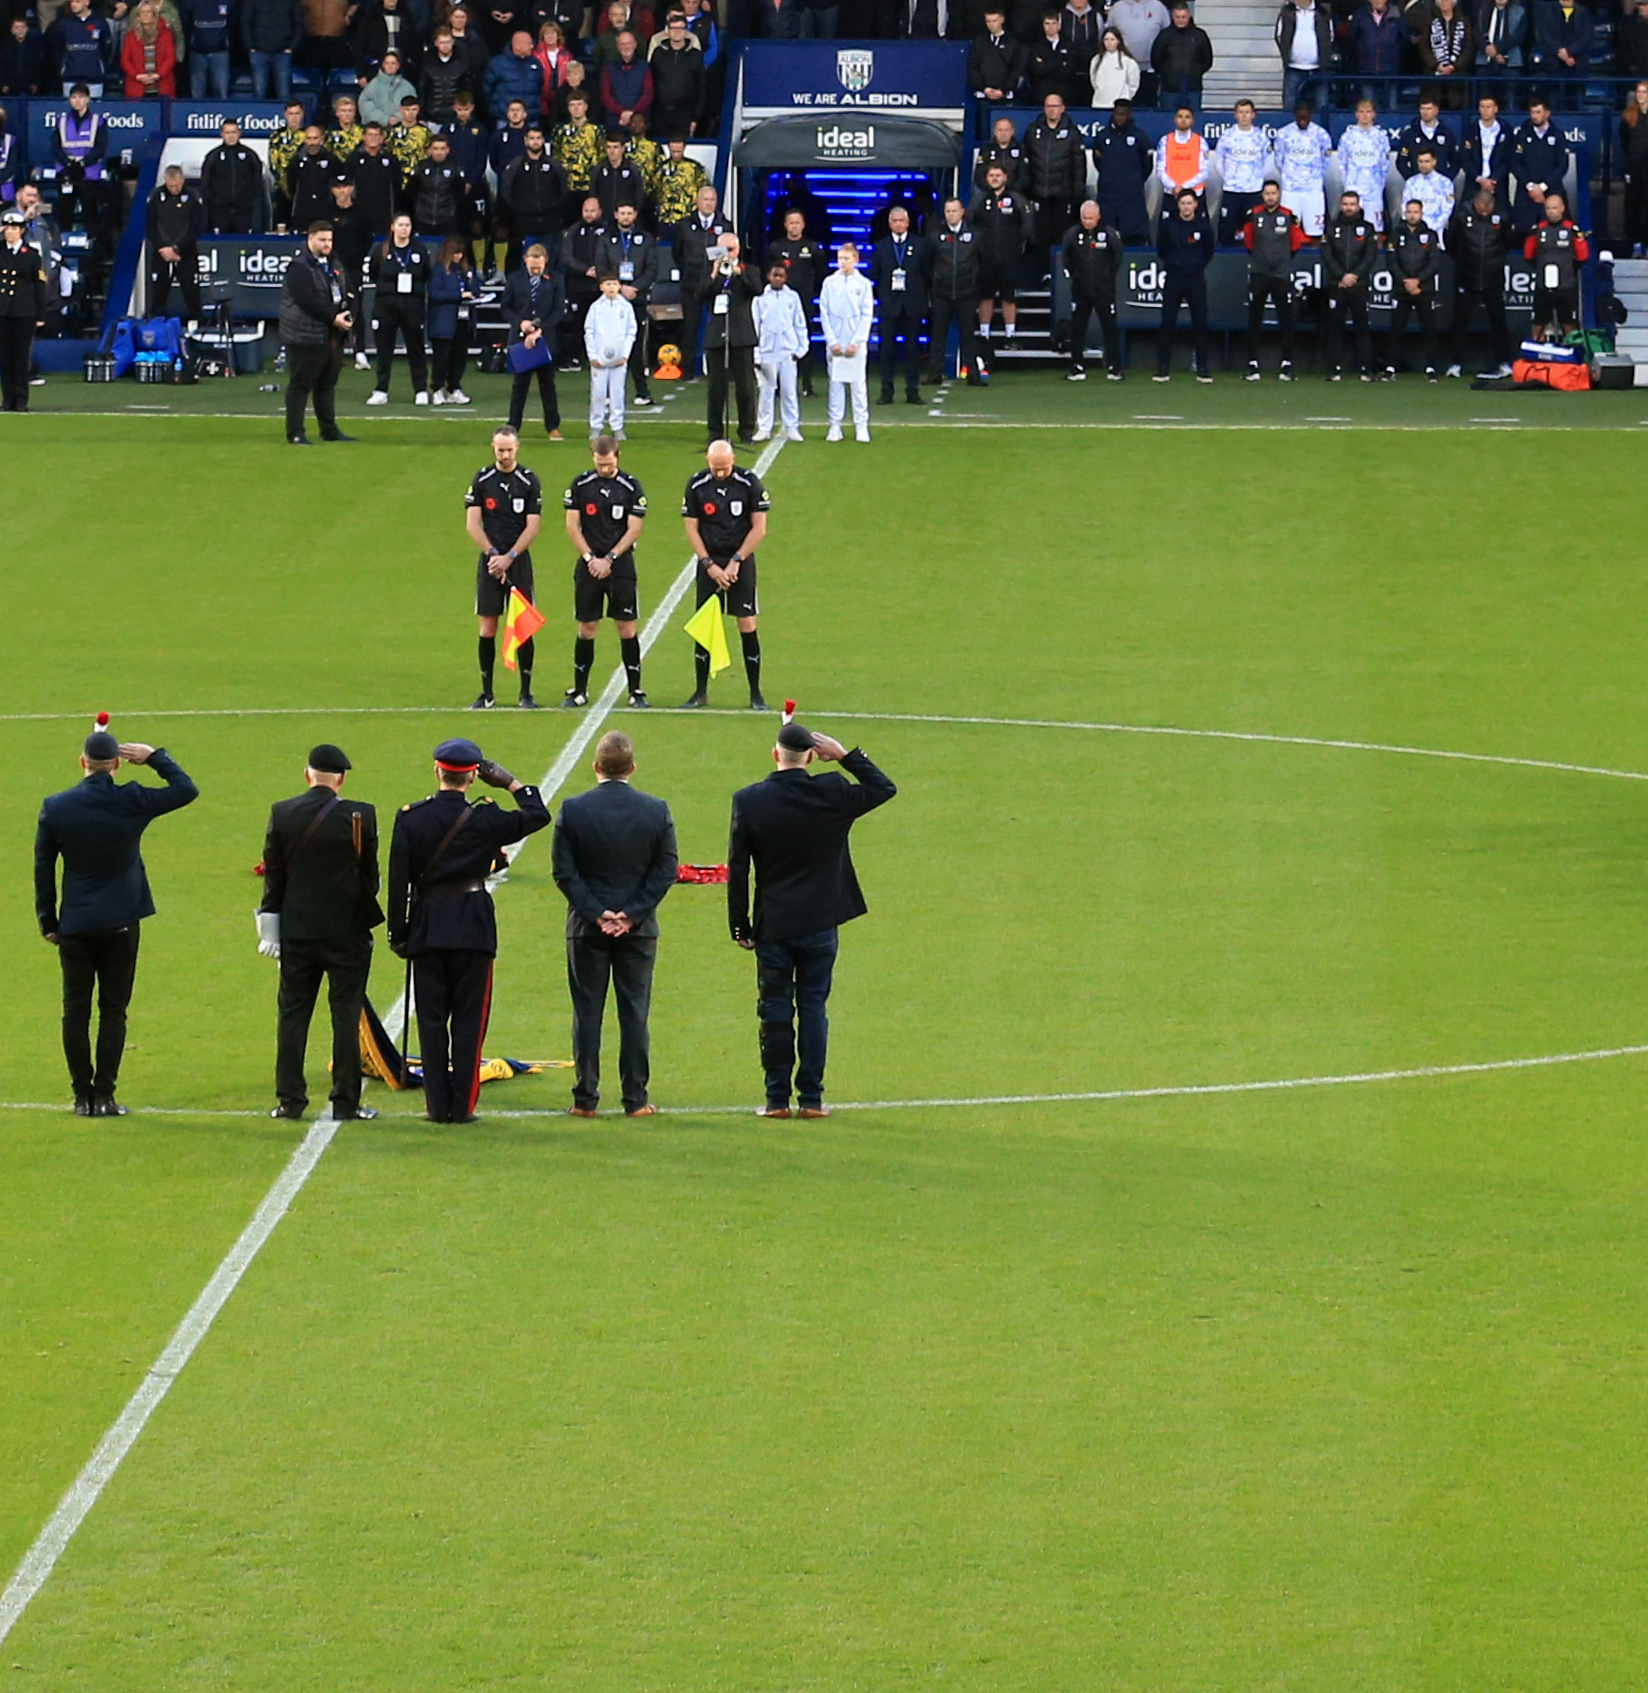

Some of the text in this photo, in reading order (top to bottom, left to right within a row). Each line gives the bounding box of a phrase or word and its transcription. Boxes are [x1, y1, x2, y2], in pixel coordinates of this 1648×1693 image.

[793, 94, 918, 105] WE ARE ALBION
[244, 114, 286, 130] foods
[817, 126, 874, 148] ideal
[240, 250, 292, 272] idea
